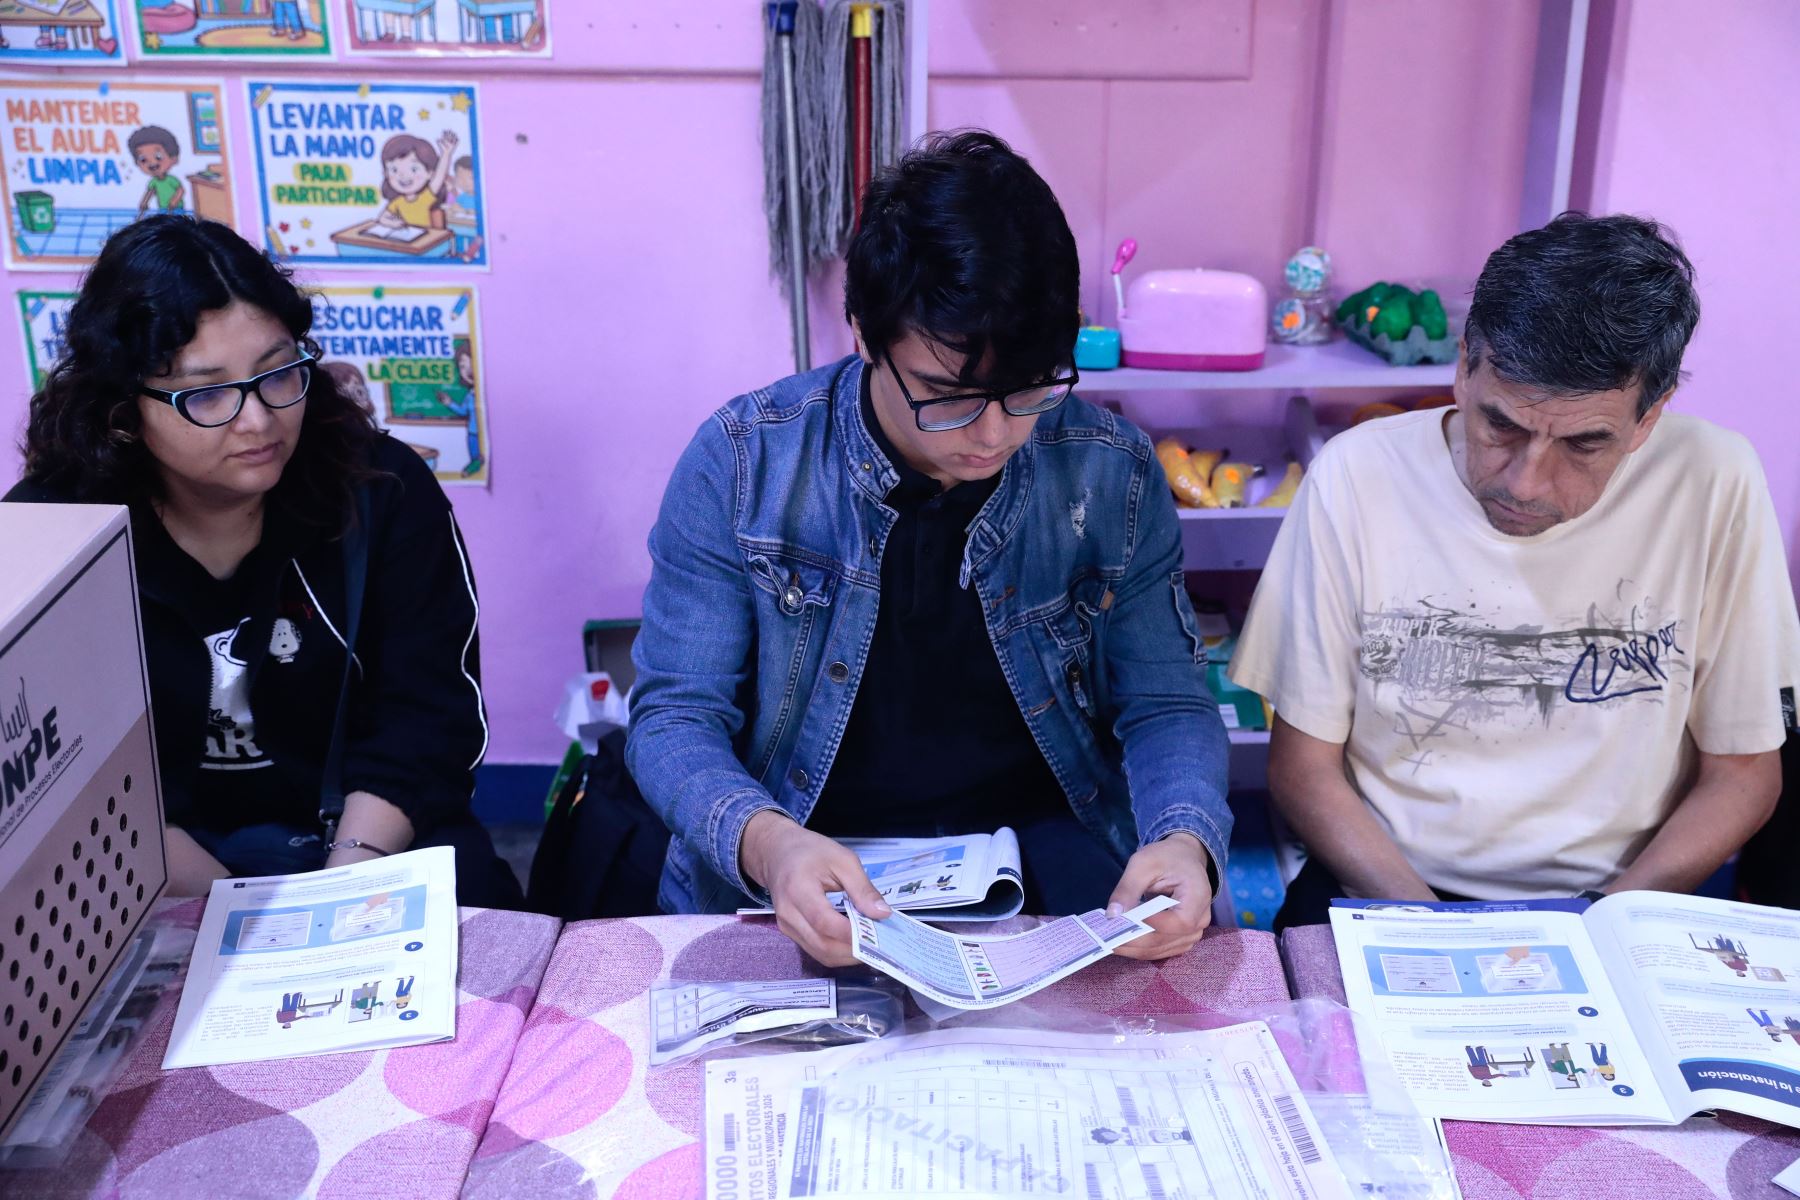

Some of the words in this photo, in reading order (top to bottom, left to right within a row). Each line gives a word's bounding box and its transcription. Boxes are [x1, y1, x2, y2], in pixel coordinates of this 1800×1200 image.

[6, 98, 142, 125] MANTENER
[267, 103, 406, 131] LEVANTAR
[13, 127, 44, 153] EL
[52, 128, 121, 154] AULA
[270, 134, 299, 157] LA
[305, 135, 375, 158] MANO
[28, 157, 122, 185] LIMPIA
[299, 163, 348, 182] PARA
[275, 184, 379, 205] PARTICIPAR
[311, 305, 444, 331] ESCUCHAR
[319, 335, 451, 357] TENTAMENTE
[367, 361, 391, 381] LA
[396, 360, 453, 381] CLASE
[0, 705, 62, 818] NPE
[24, 770, 53, 808] Procesos
[50, 732, 84, 775] Electorales
[724, 1070, 737, 1084] 3a
[1697, 1071, 1779, 1090] instalación
[1778, 1081, 1794, 1094] la
[762, 1094, 773, 1110] 2026
[744, 1076, 763, 1167] ELECTORALES
[763, 1111, 775, 1153] MUNICIPALES
[1280, 1149, 1292, 1166] hoja
[747, 1169, 764, 1200] TOS
